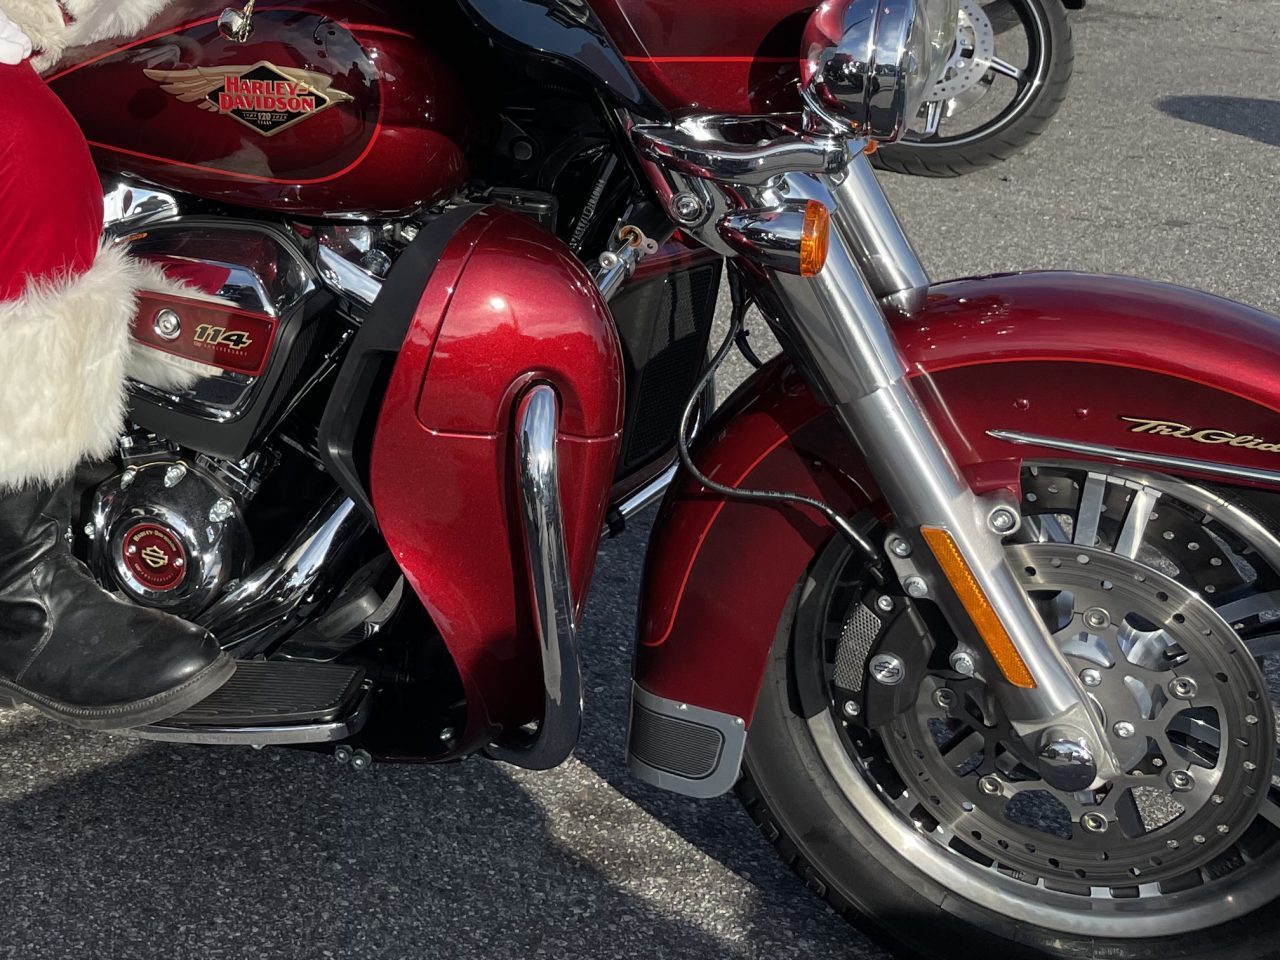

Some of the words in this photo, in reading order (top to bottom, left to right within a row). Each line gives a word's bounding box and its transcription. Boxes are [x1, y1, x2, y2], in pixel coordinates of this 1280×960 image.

[224, 74, 309, 96] HARLEY-
[219, 92, 315, 113] DAVIDSON
[257, 112, 271, 121] 120
[193, 324, 252, 349] 114
